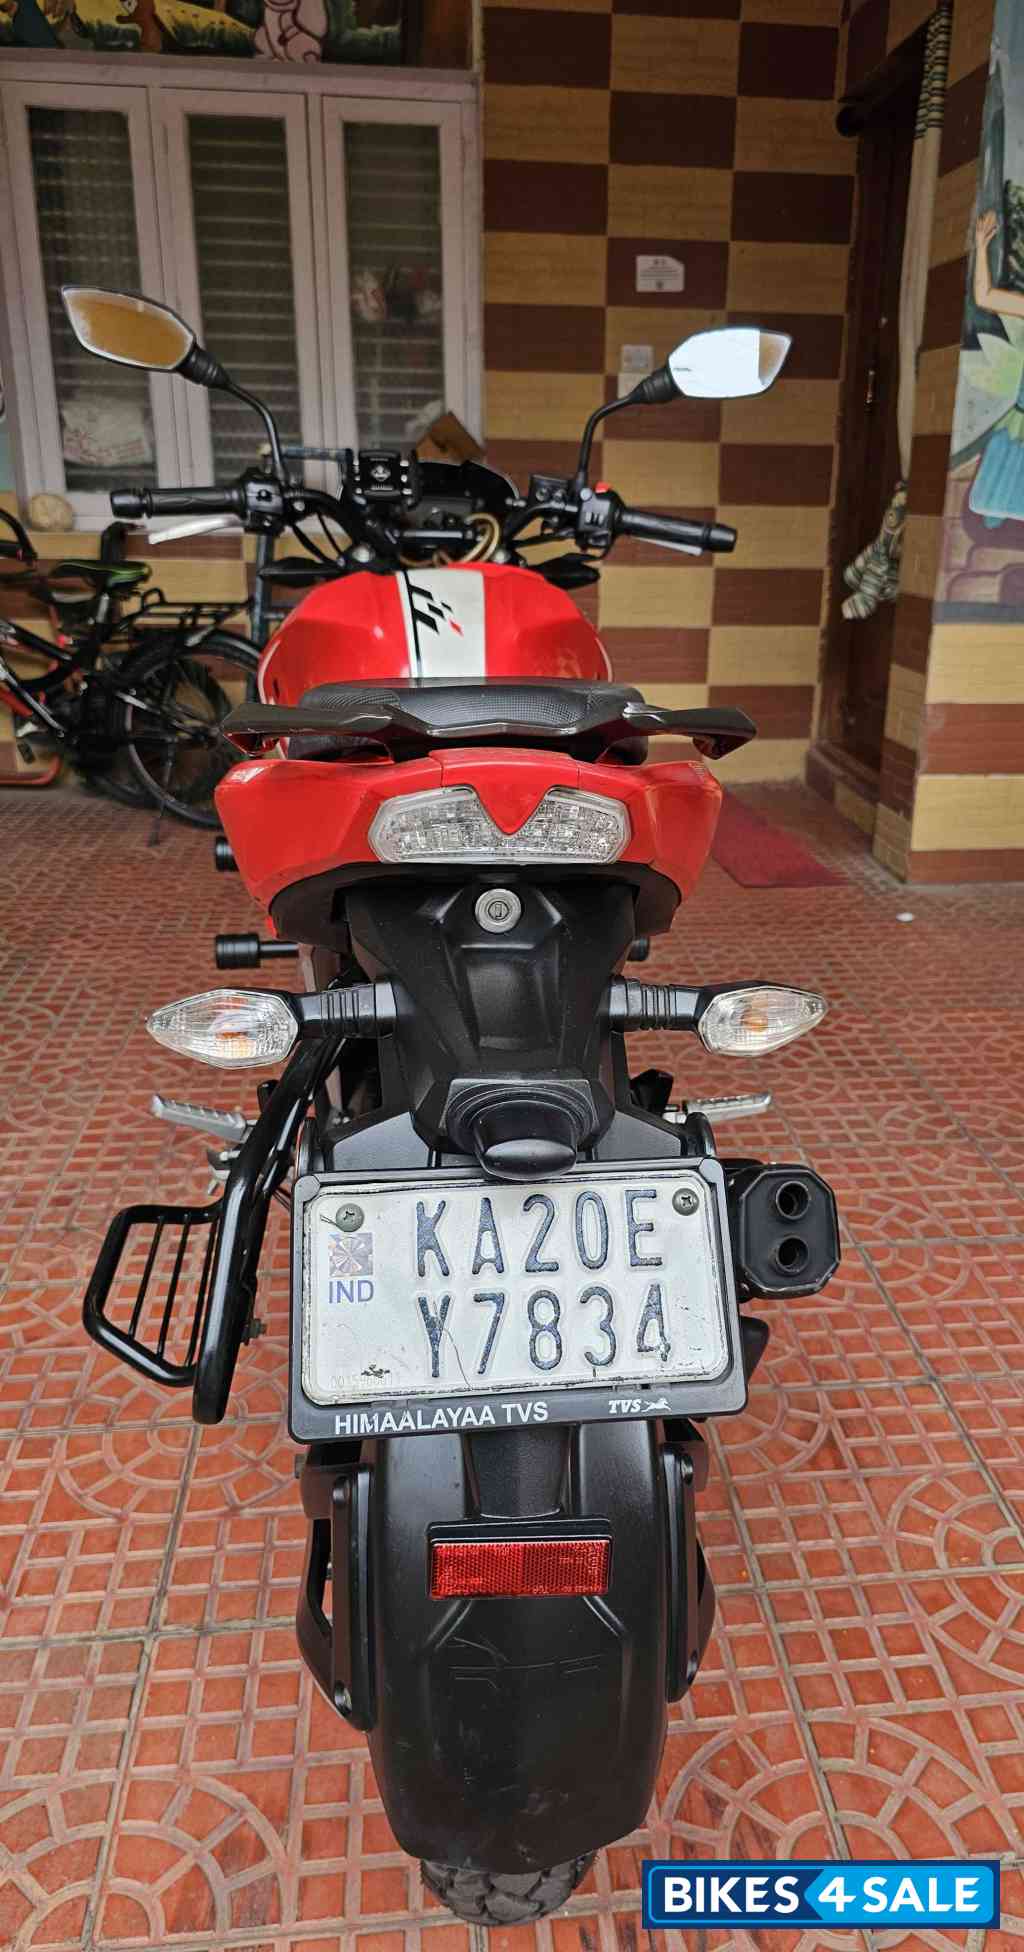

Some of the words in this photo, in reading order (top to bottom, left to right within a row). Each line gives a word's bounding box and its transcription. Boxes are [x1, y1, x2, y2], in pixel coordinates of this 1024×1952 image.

[415, 1188, 663, 1278] KA20E
[328, 1279, 374, 1304] IND
[417, 1283, 672, 1378] Y7834
[335, 1405, 496, 1435] HIMAALAYAA
[501, 1401, 549, 1424] TVS
[608, 1398, 642, 1414] TVS
